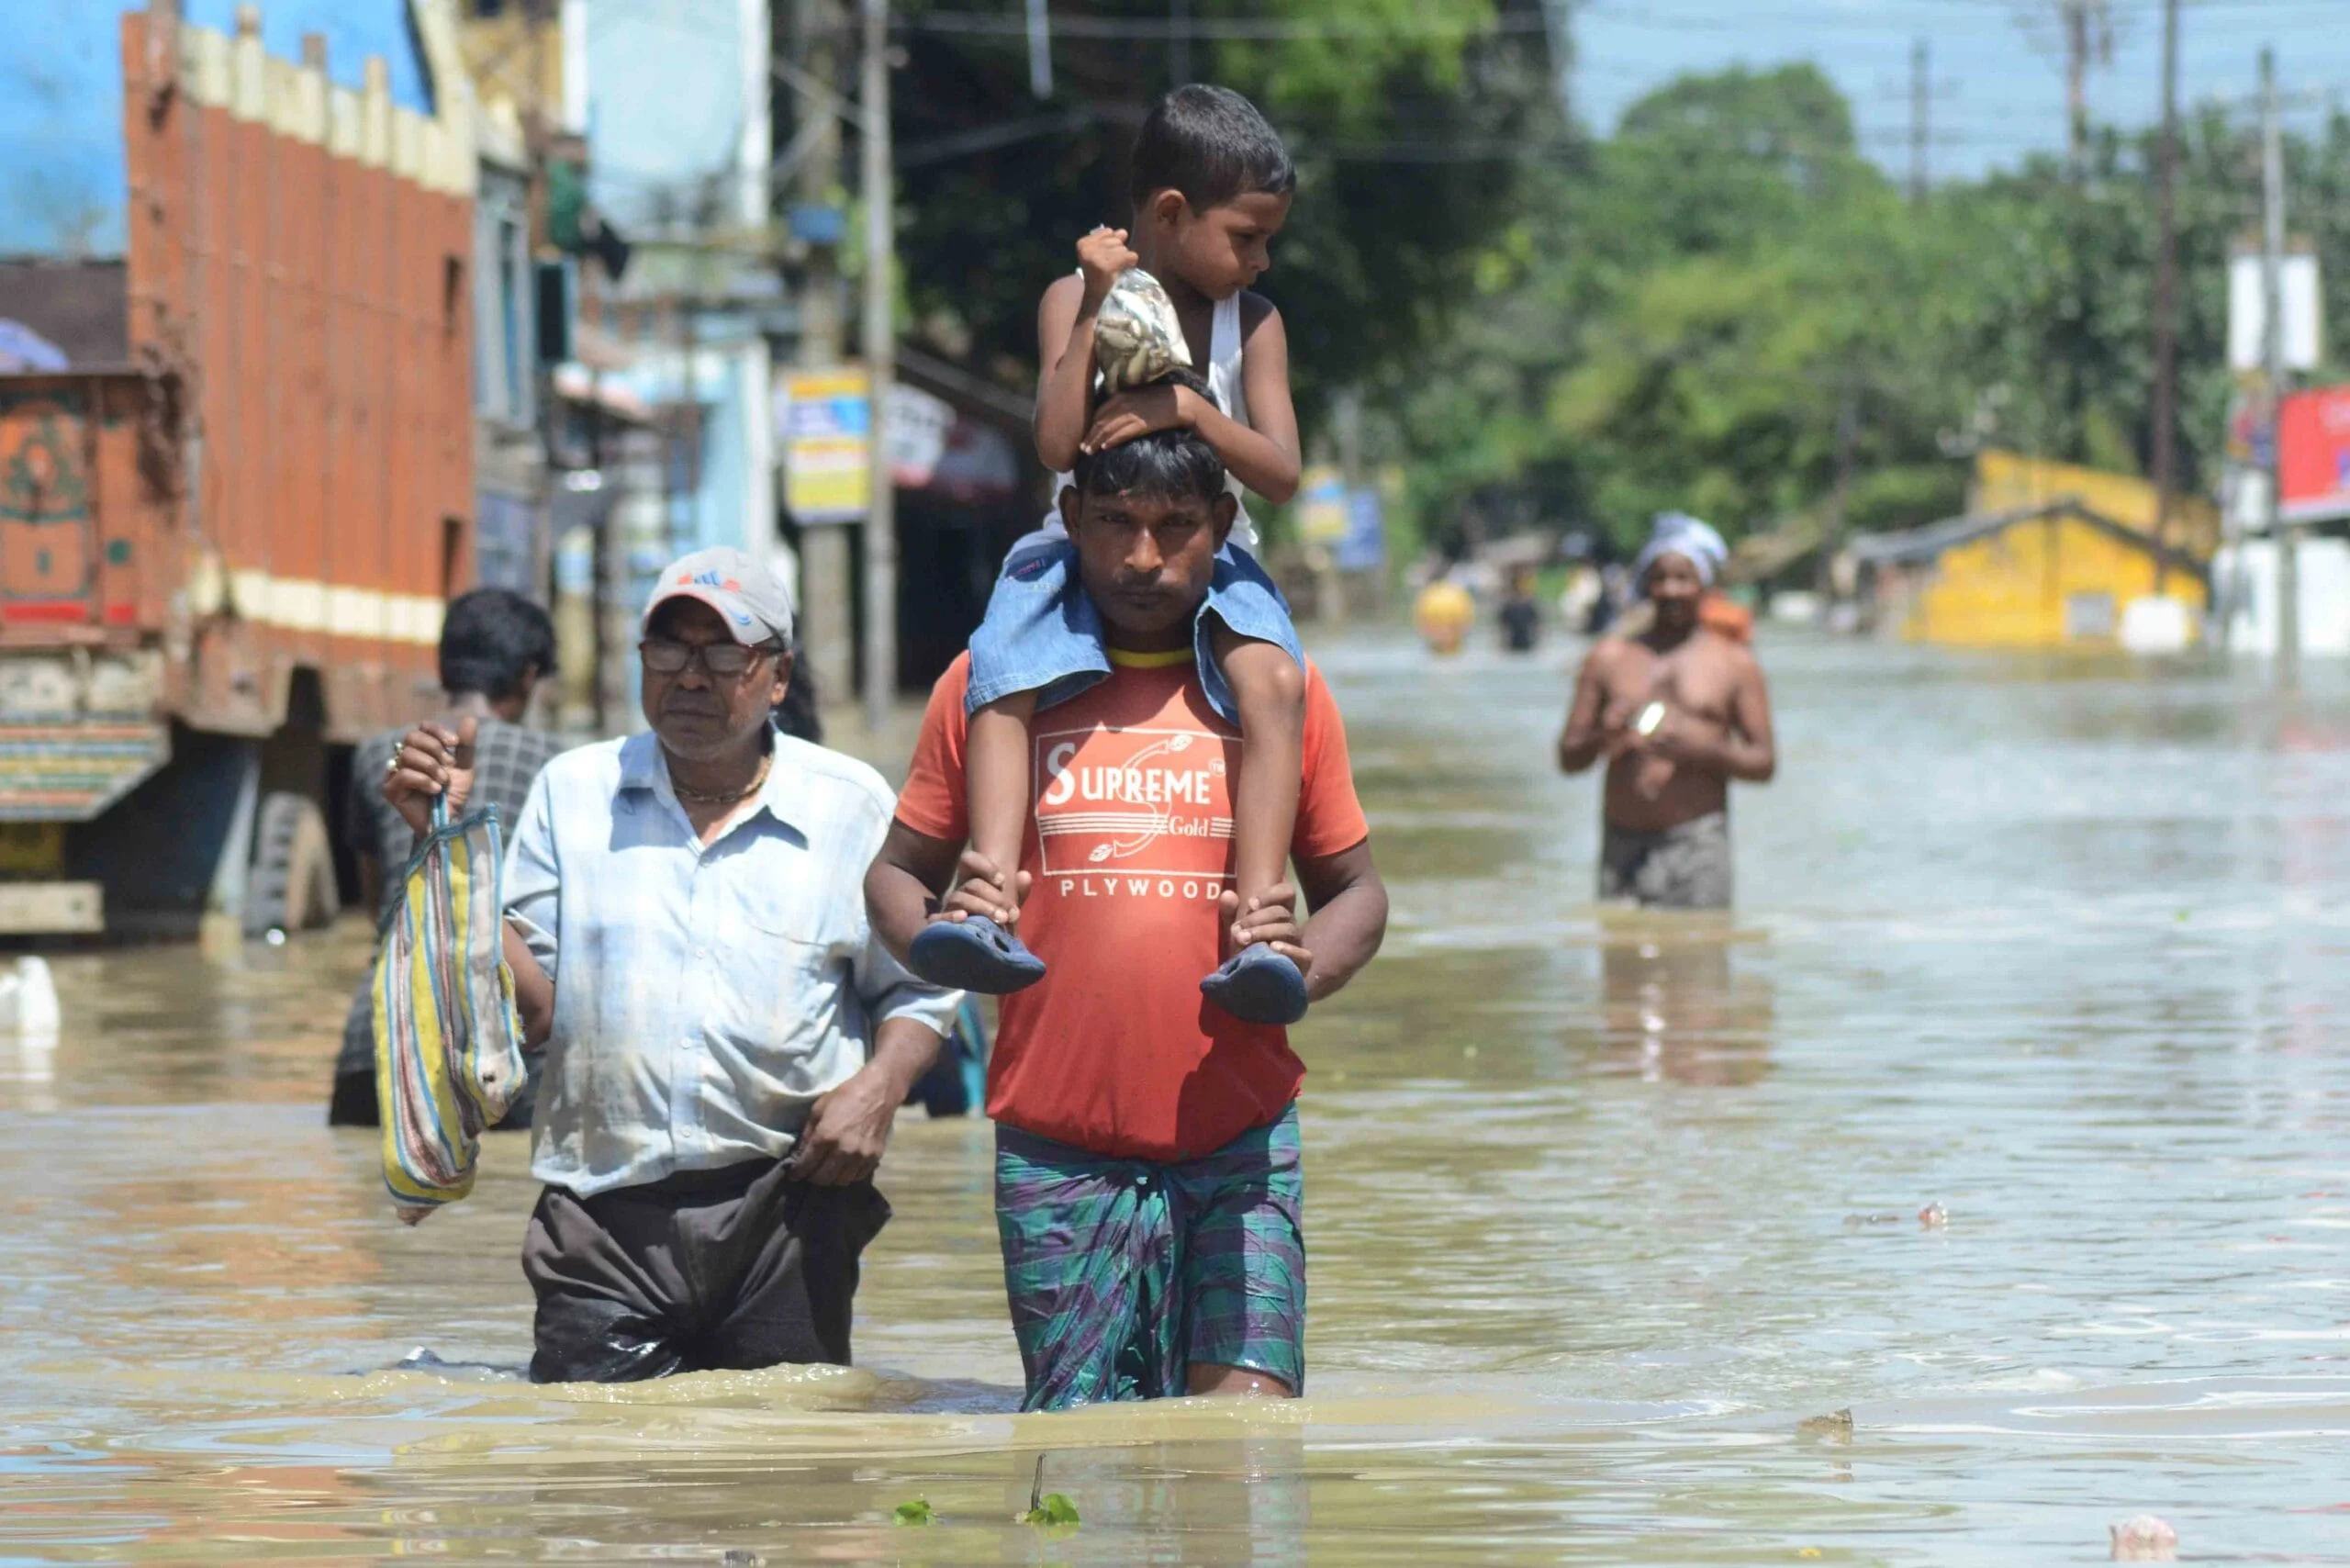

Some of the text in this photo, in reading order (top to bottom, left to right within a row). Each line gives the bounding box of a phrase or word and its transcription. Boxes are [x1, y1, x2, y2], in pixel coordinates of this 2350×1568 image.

[1046, 743, 1211, 805] SUPREME
[1169, 815, 1209, 836] Gold
[1061, 879, 1221, 900] PLYWOOD
